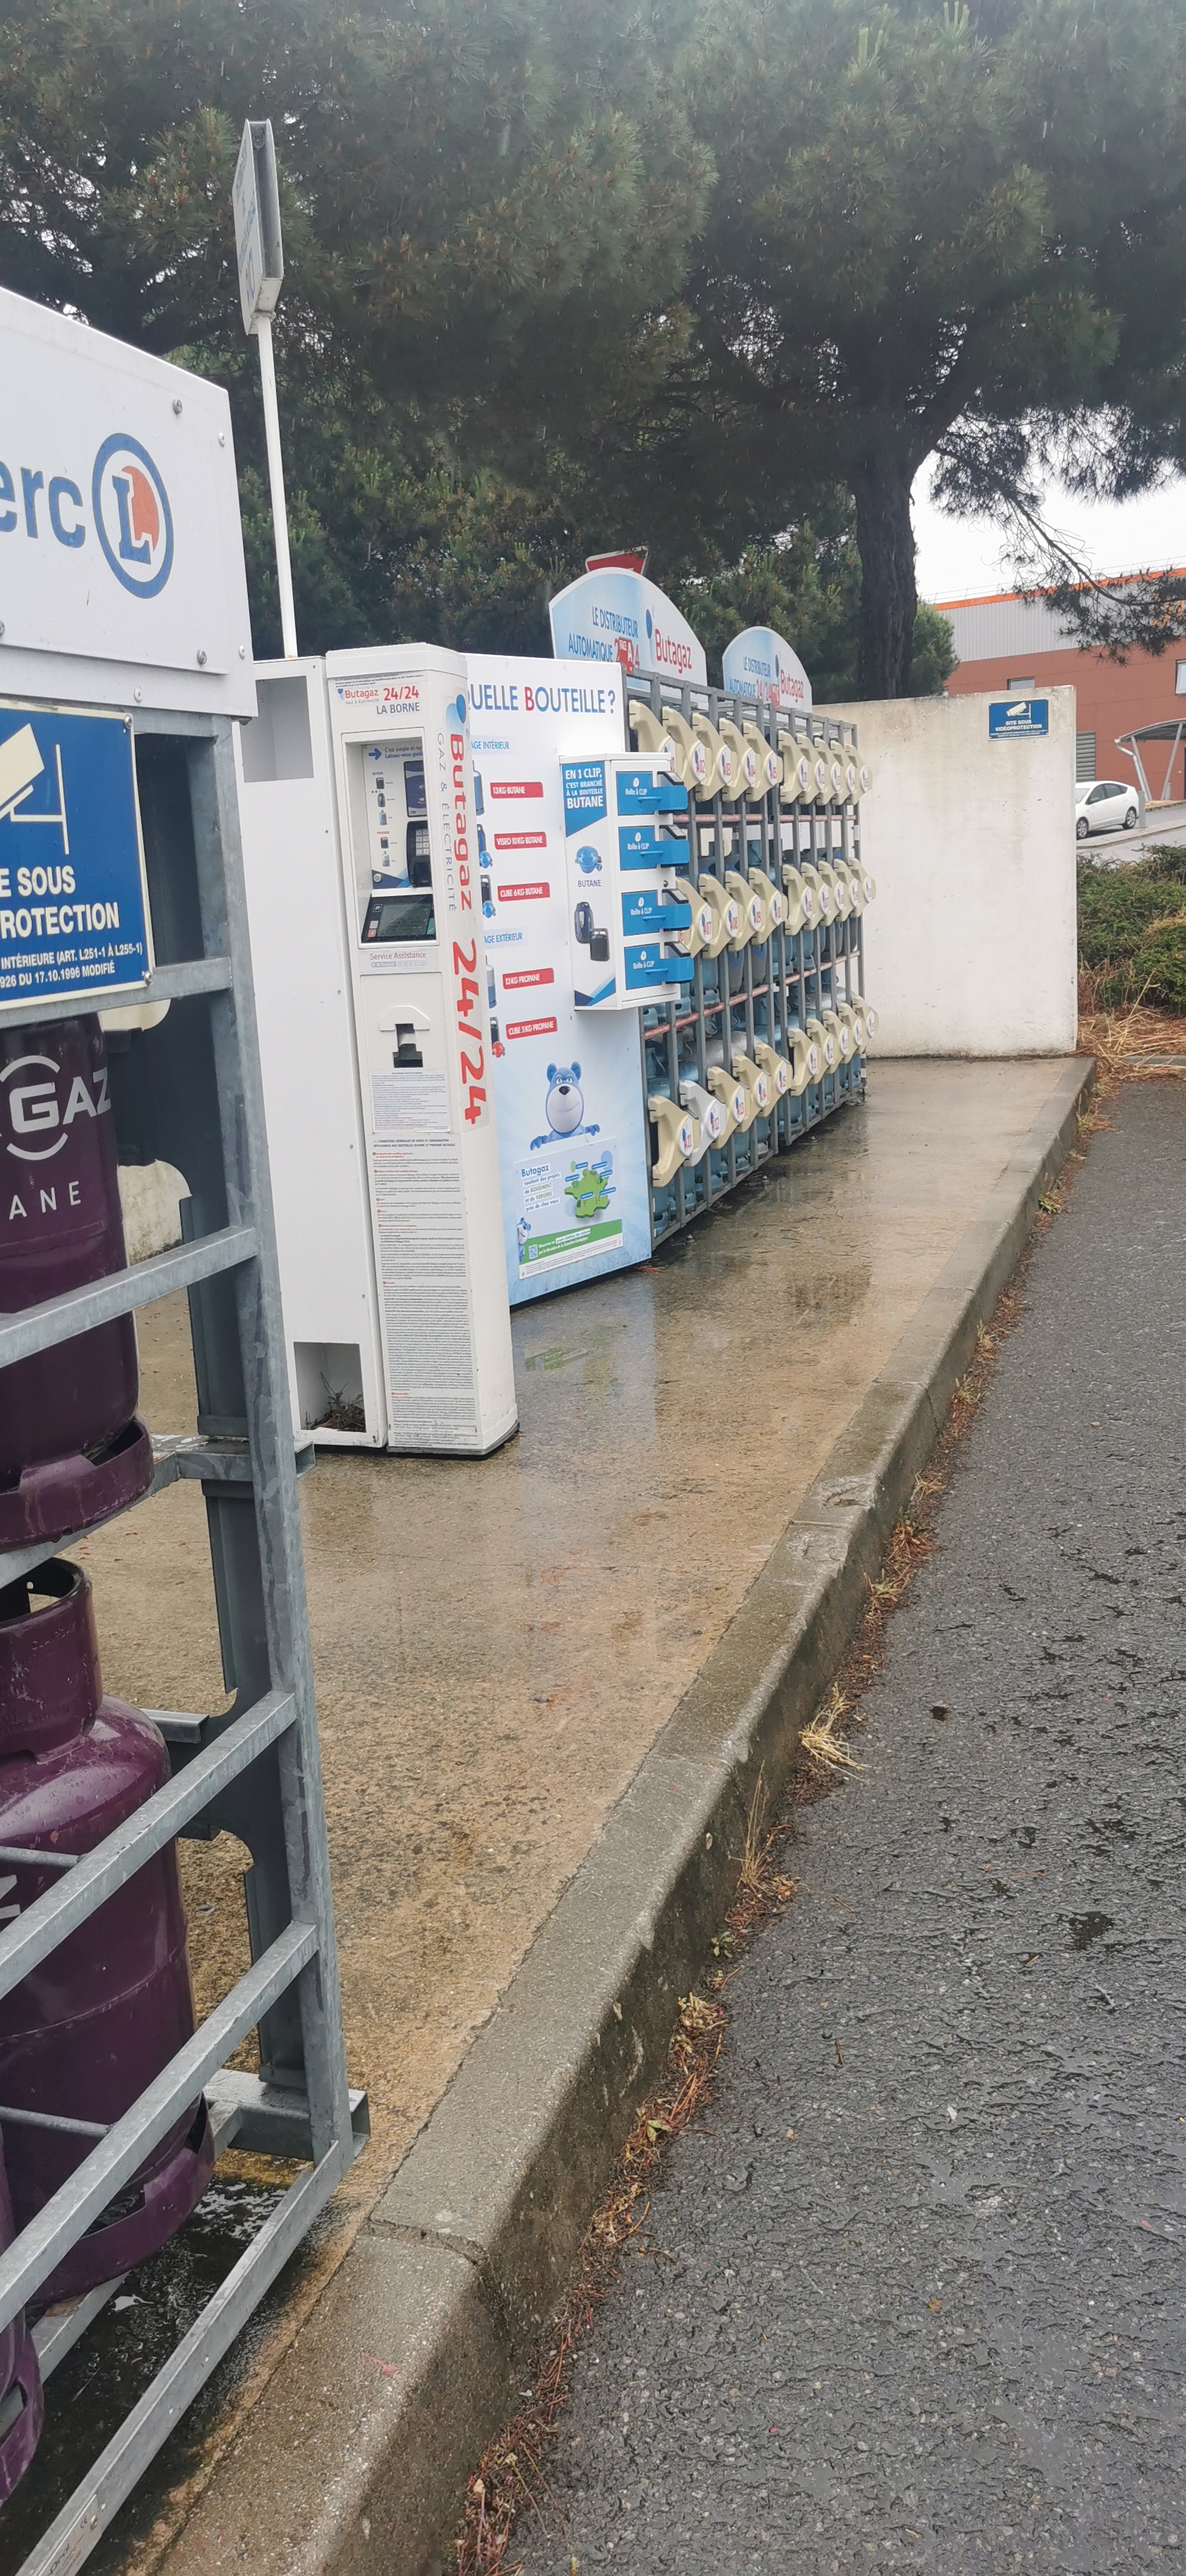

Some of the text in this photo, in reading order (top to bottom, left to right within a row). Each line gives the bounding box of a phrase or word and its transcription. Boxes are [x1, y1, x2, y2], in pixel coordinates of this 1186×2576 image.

[592, 606, 639, 638] LE DISTRIBUTEUR
[568, 633, 613, 662] AUTOMATIQUE
[654, 628, 692, 674] Butagaz
[345, 685, 419, 701] Butagaz 24/24
[781, 669, 804, 703] Butagaz
[469, 684, 519, 710] UELLE
[376, 702, 421, 715] LA BORNE
[471, 739, 510, 749] AGE INTÉRIEUR
[565, 767, 602, 780] EN 1 CLIP,
[507, 786, 526, 794] BUTANE
[580, 779, 603, 788] BRANCHÉ
[567, 796, 604, 809] BUTANE
[437, 732, 446, 772] GAZ
[442, 803, 457, 912] ÉLECTRICITÉ
[450, 733, 472, 911] Butagaz
[496, 837, 512, 846] VISEO
[525, 835, 544, 845] BUTANE
[17, 865, 76, 897] SOUS
[501, 889, 513, 898] CUBE
[525, 886, 544, 895] BUTANE
[0, 902, 120, 940] ROTECTION
[484, 931, 523, 944] AGE EXTÉRIEUR
[1, 941, 143, 970] INTÉRIEURE (ART. L251-1 À L255-1)
[370, 951, 426, 960] Service Assistance
[0, 960, 116, 989] 926 DU 17.10.1996 MODIFIÉ
[519, 973, 541, 984] PROPANE
[453, 937, 487, 1125] 24/24
[508, 1027, 521, 1036] CUBE
[533, 1020, 554, 1032] PROPANE
[683, 1137, 693, 1150] A11
[521, 1165, 549, 1177] Butagaz
[524, 1178, 539, 1186] soutient
[547, 1172, 561, 1181] projets
[530, 1183, 552, 1193] BOISEMENT
[9, 1181, 81, 1220] ANE
[535, 1191, 553, 1200] VERGERS
